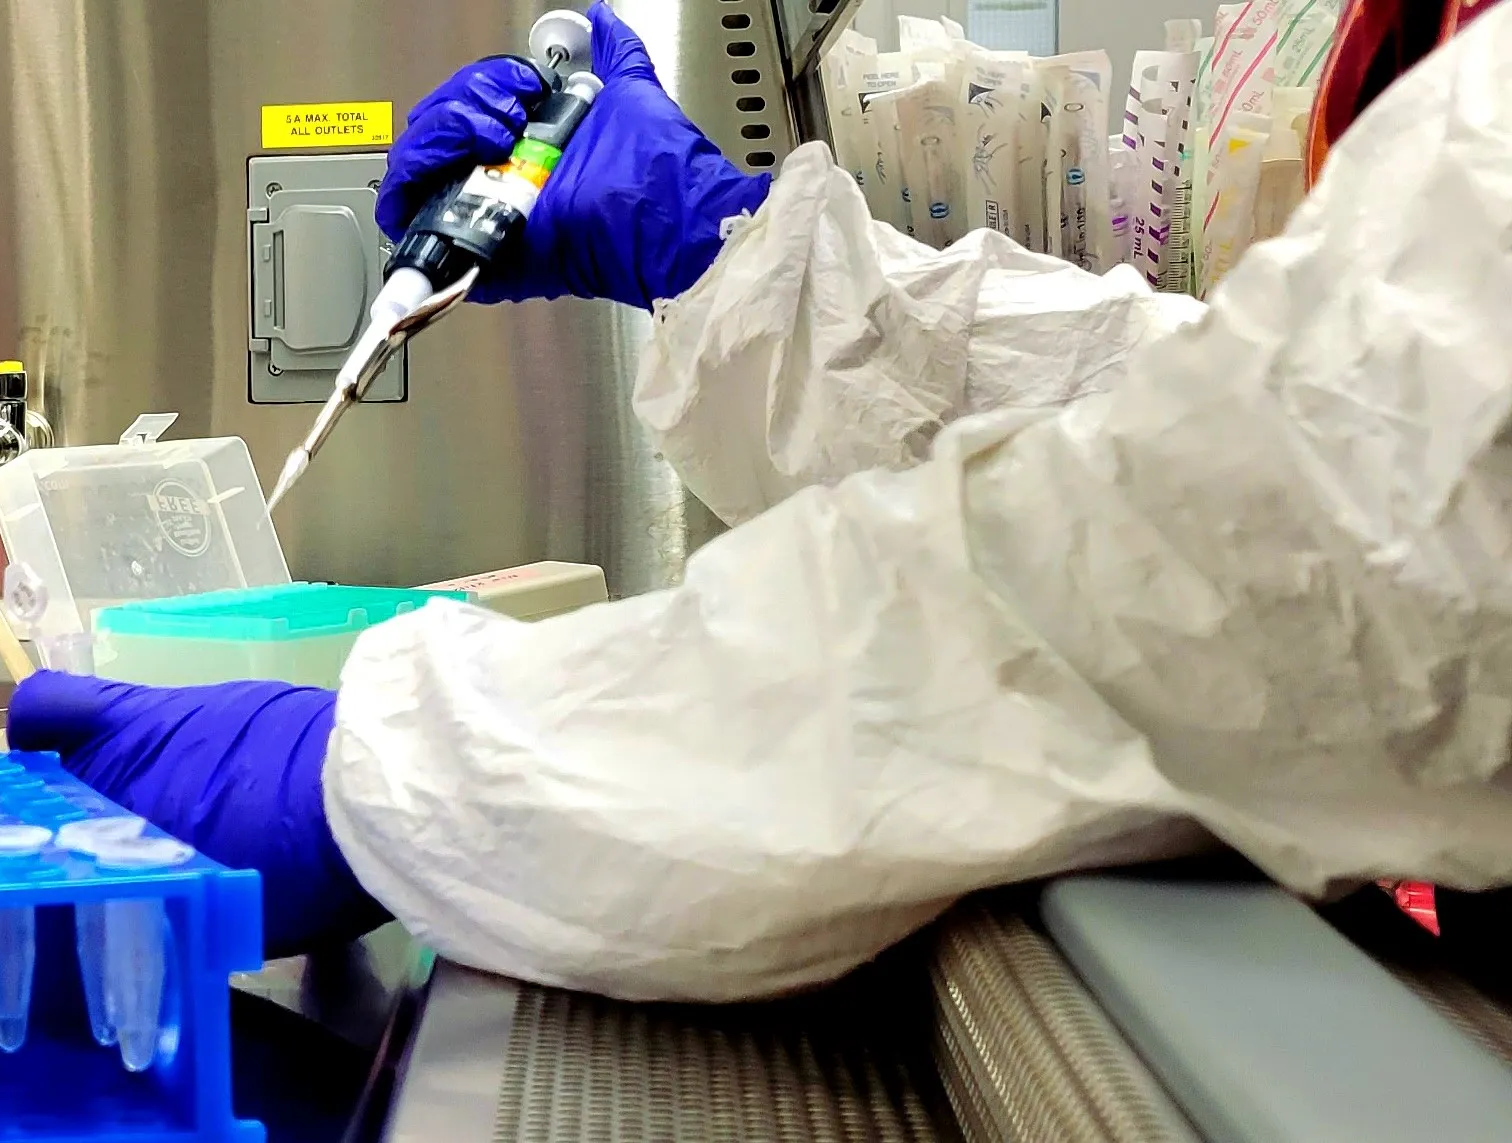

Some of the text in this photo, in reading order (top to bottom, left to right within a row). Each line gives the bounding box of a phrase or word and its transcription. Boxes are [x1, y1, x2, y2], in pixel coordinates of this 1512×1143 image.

[336, 112, 368, 121] TOTAL
[290, 125, 364, 135] ALL OUTLETS
[1132, 216, 1145, 259] 25 mL
